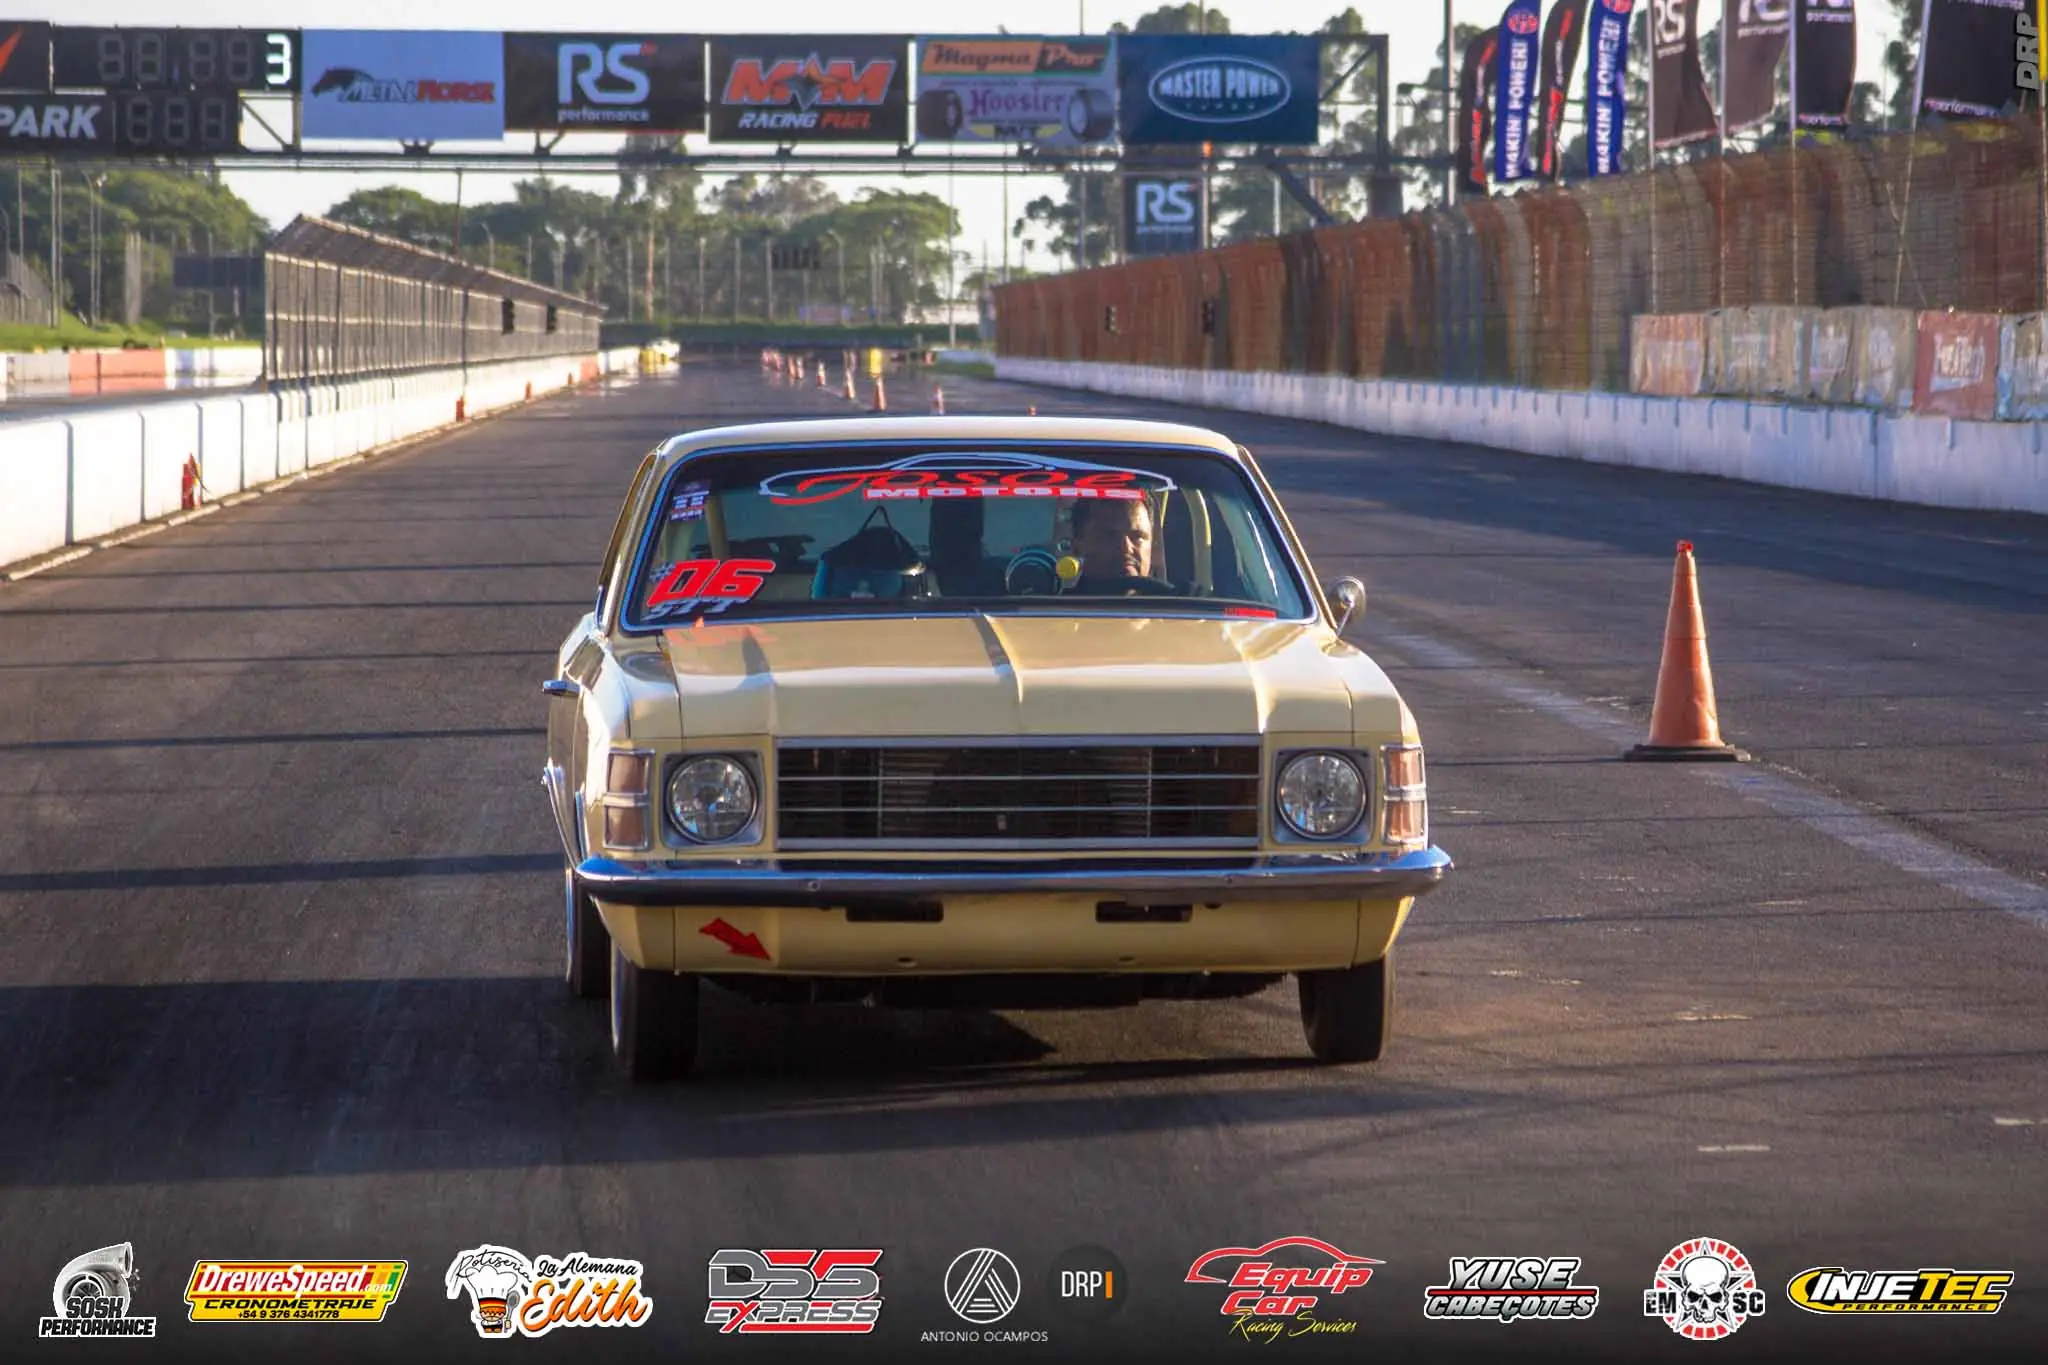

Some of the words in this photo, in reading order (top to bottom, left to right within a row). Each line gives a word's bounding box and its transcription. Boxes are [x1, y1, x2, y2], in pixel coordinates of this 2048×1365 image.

[265, 33, 291, 84] 3
[558, 43, 649, 105] RS
[1159, 68, 1222, 98] MASTER
[1225, 68, 1280, 98] POWER
[0, 104, 102, 139] PARK
[738, 112, 820, 129] RACING
[1137, 183, 1195, 223] RS
[647, 559, 776, 608] 06
